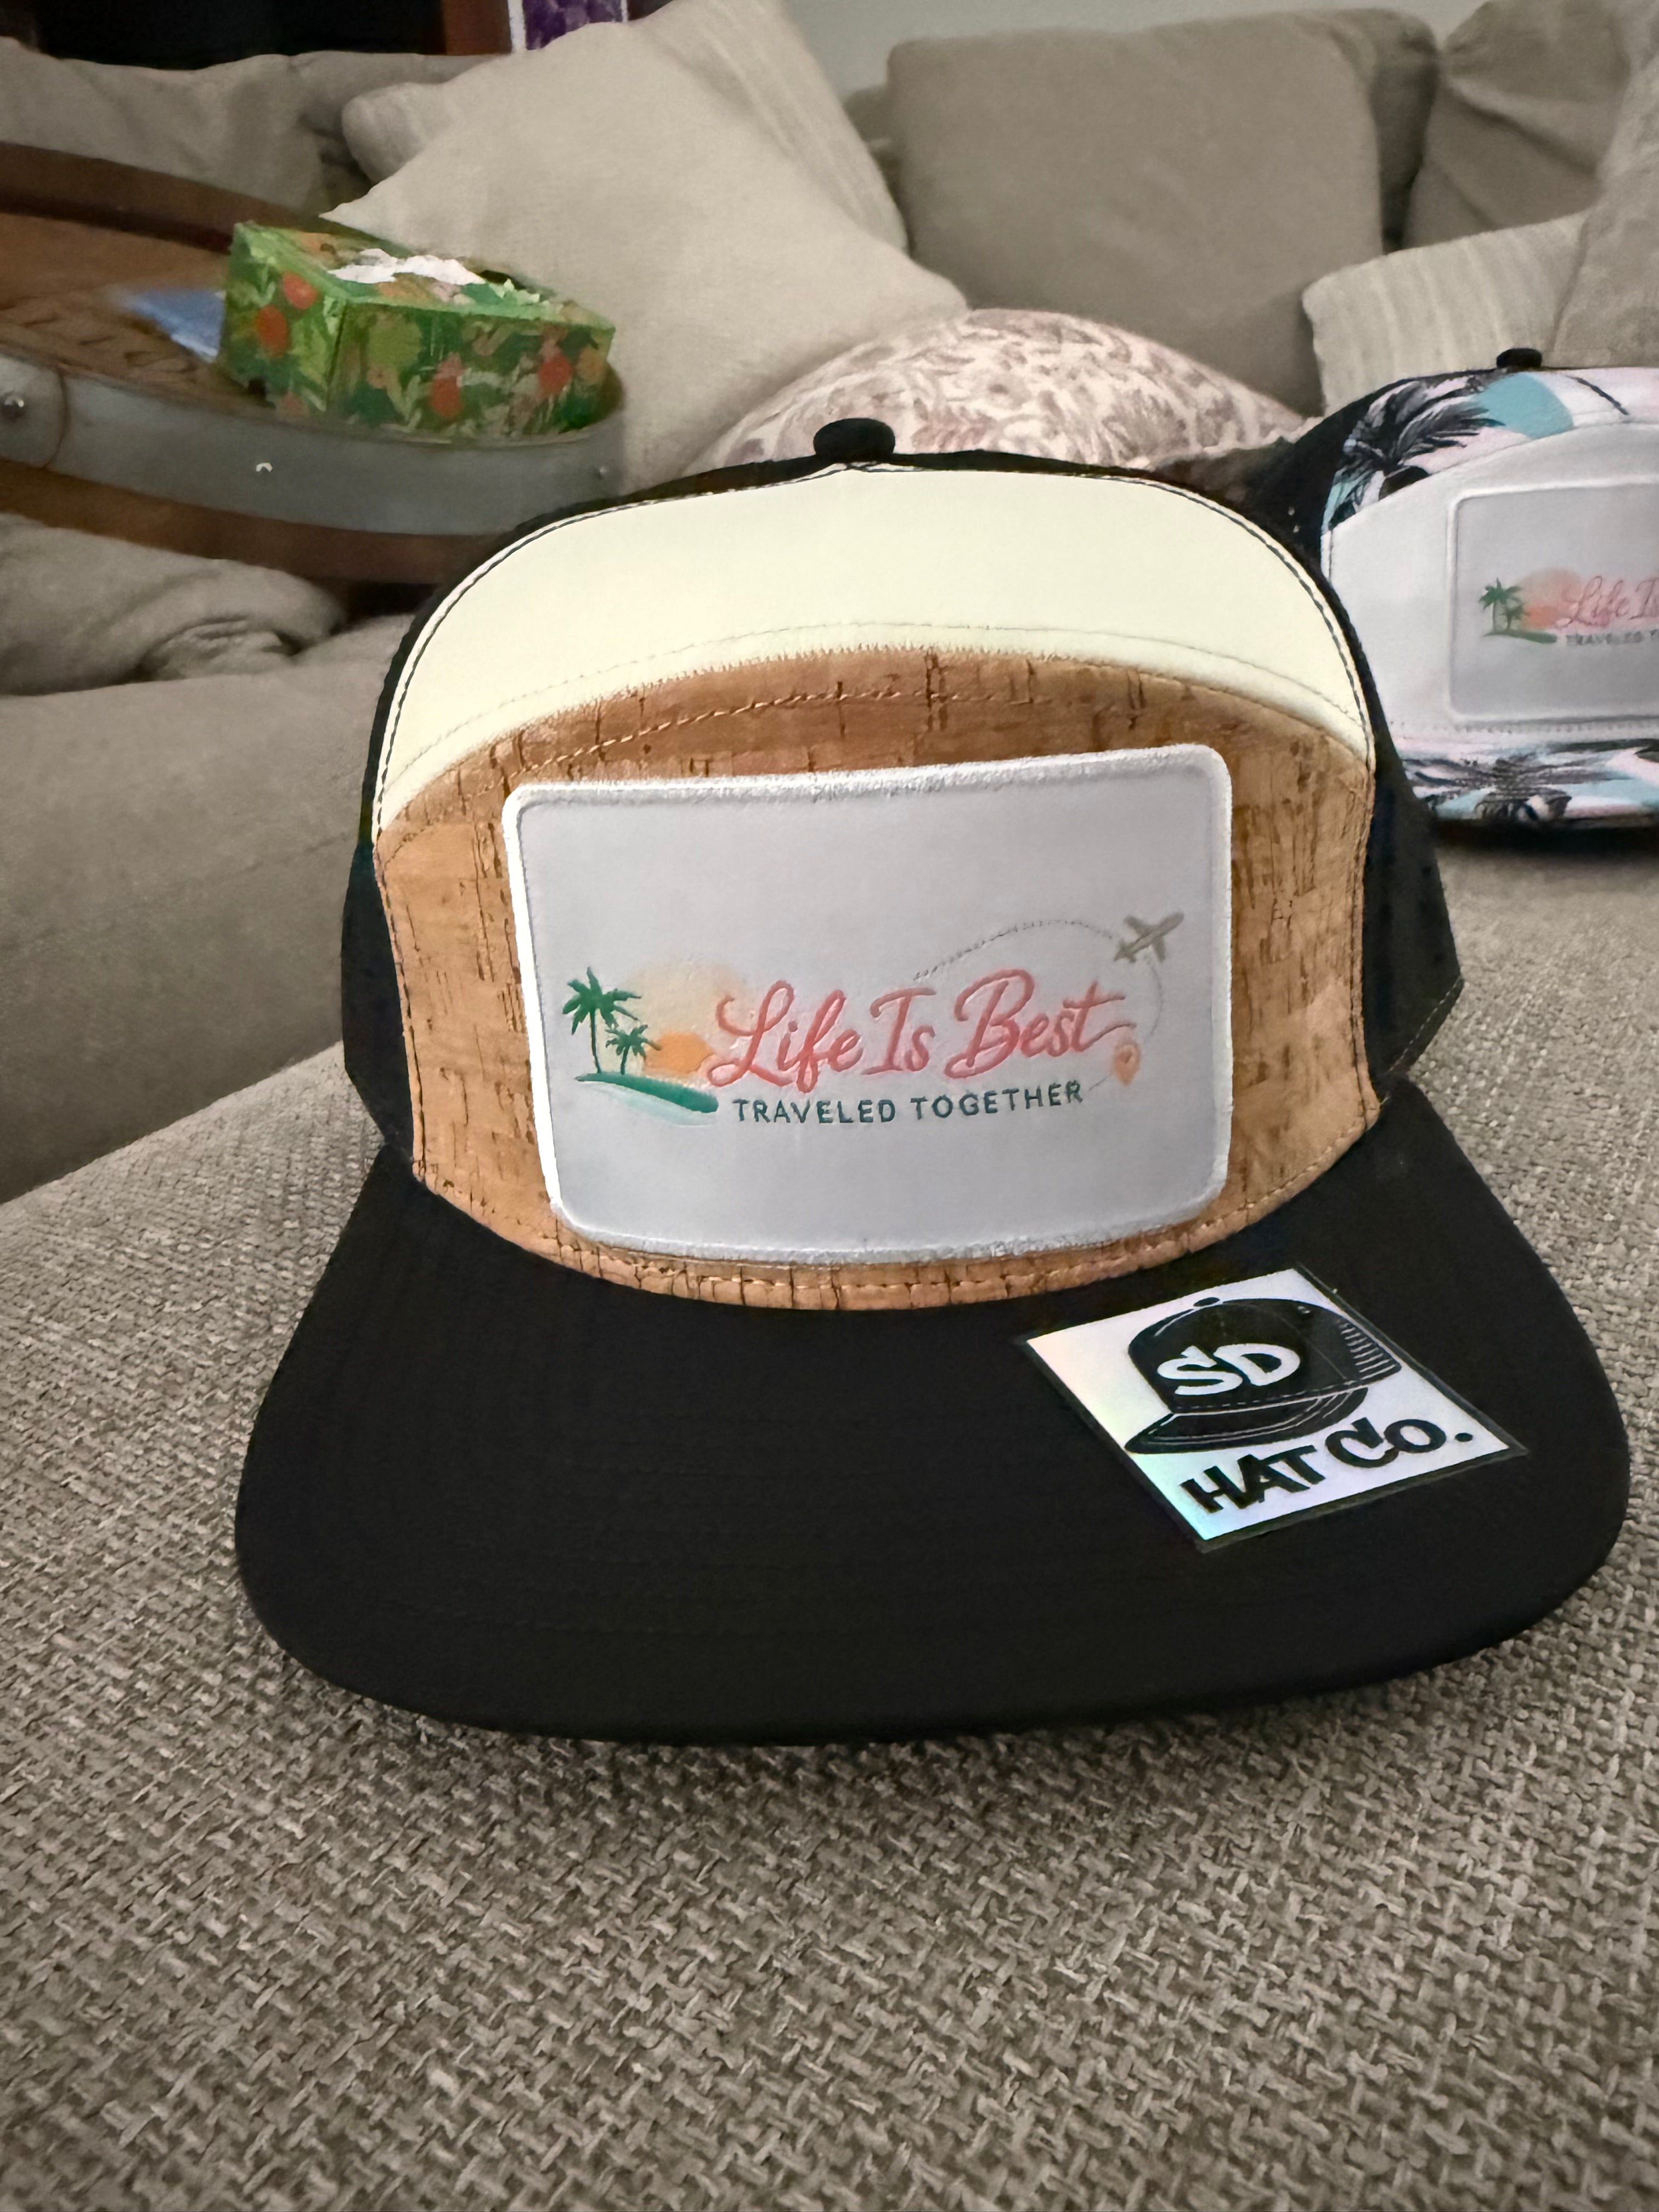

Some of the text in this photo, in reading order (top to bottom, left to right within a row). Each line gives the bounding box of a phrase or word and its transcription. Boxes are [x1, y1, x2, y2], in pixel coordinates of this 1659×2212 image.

[1553, 575, 1629, 629] Life
[707, 969, 1136, 1093] Life Is Best
[732, 1080, 1083, 1123] TRAVELED TOGETHER
[1158, 1344, 1300, 1395] SD
[1180, 1445, 1325, 1513] HAT
